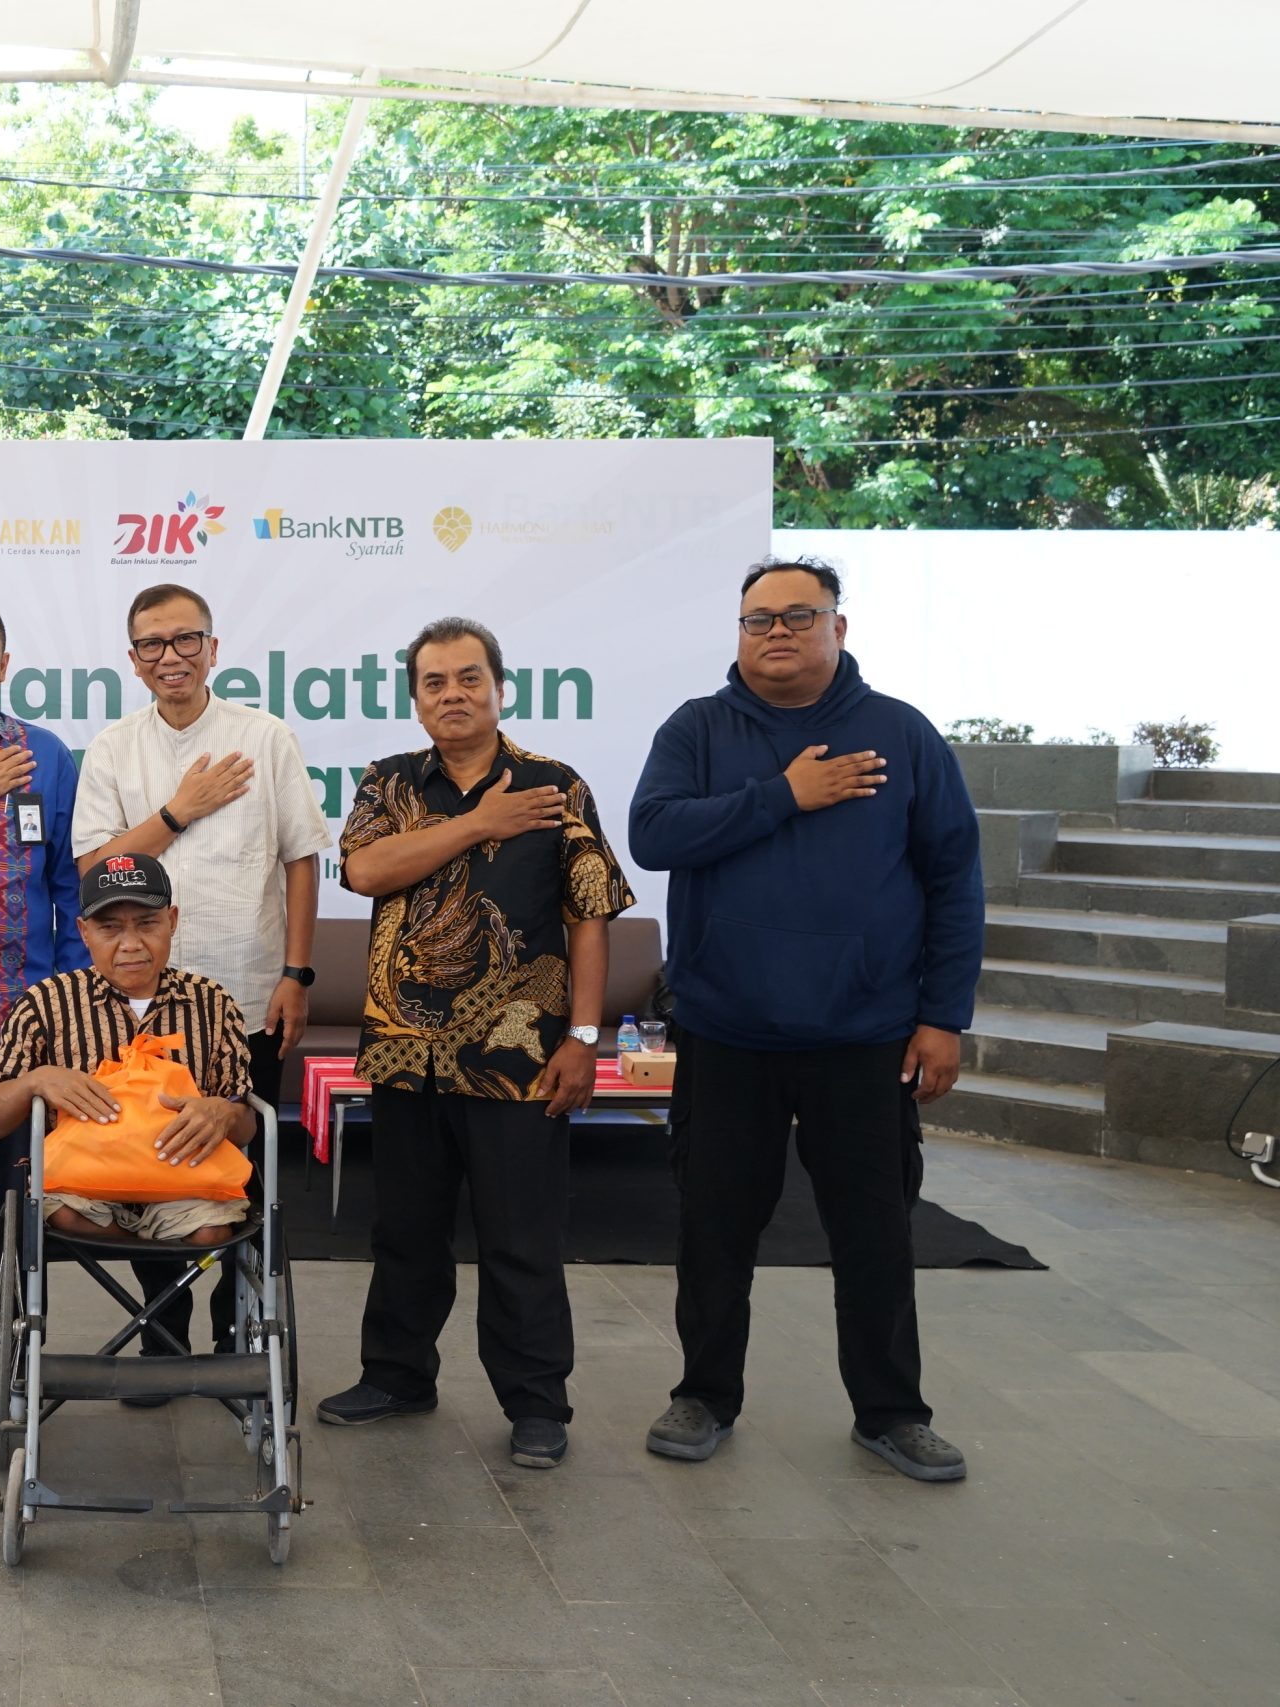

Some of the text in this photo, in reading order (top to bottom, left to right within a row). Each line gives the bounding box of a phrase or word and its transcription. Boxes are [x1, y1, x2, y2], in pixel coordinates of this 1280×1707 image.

[40, 548, 81, 556] Keuangan
[345, 540, 405, 560] Syariah
[160, 558, 197, 566] Keuangan
[151, 649, 593, 721] elatian
[106, 856, 136, 873] THE
